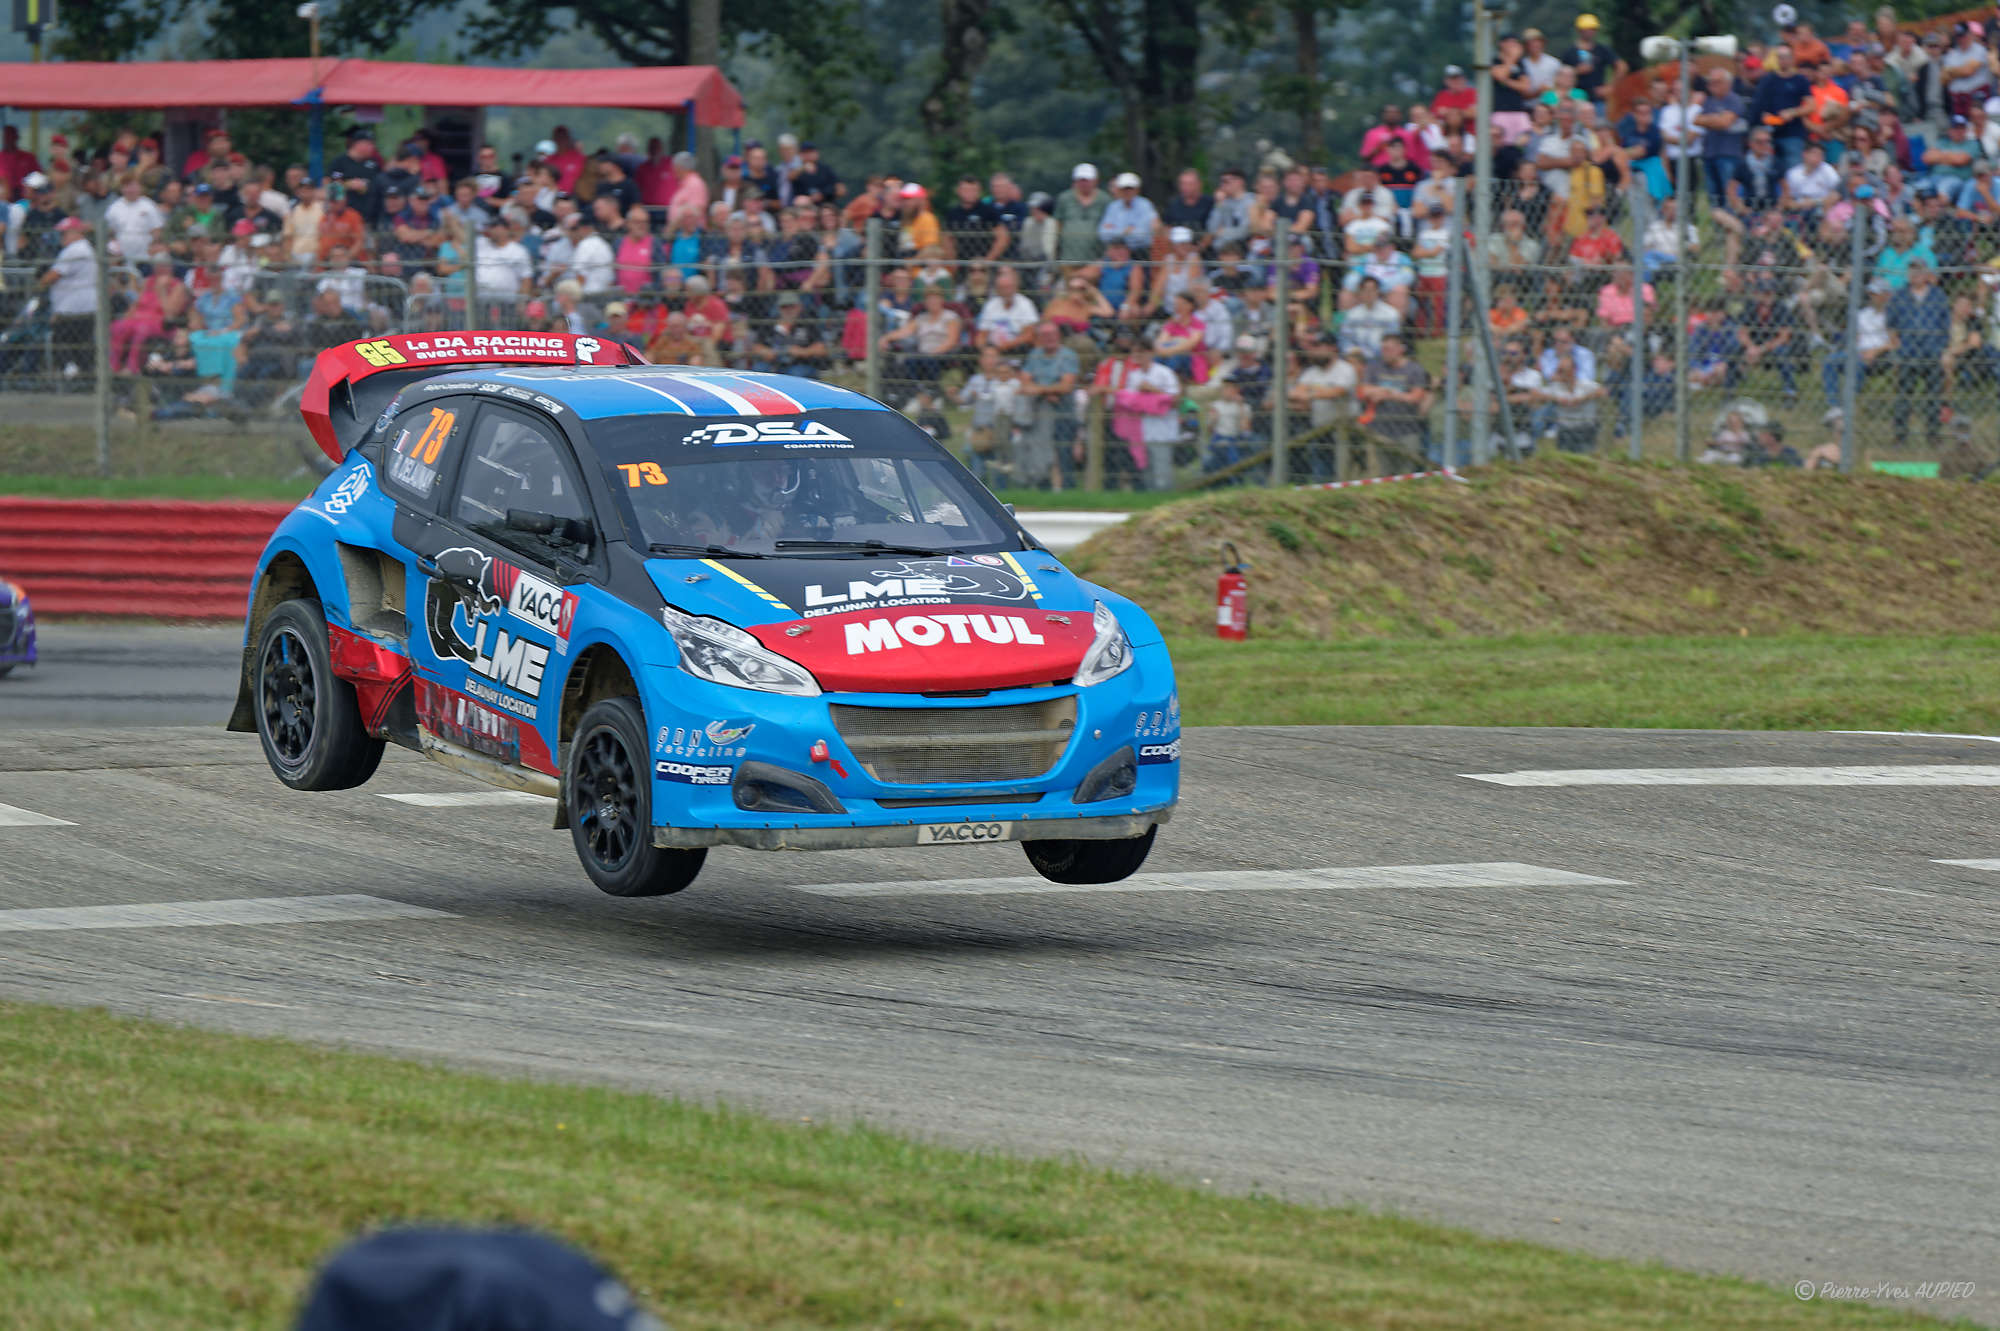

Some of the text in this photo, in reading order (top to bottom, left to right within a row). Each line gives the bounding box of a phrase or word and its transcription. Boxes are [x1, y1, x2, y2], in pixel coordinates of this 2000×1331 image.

[355, 339, 408, 367] 95
[406, 336, 564, 350] Le DA RACING
[416, 347, 568, 360] avec toi Laurent
[410, 407, 455, 464] 73
[704, 420, 852, 444] DSA
[617, 461, 669, 488] 73
[804, 578, 948, 607] LME
[803, 597, 951, 618] DELAUNAY LOCATION
[843, 614, 1045, 655] MOTUL
[470, 619, 550, 700] LME
[656, 744, 746, 757] recycling
[656, 762, 733, 777] COOPER
[691, 775, 730, 784] TIRES
[928, 823, 1003, 841] YACCO
